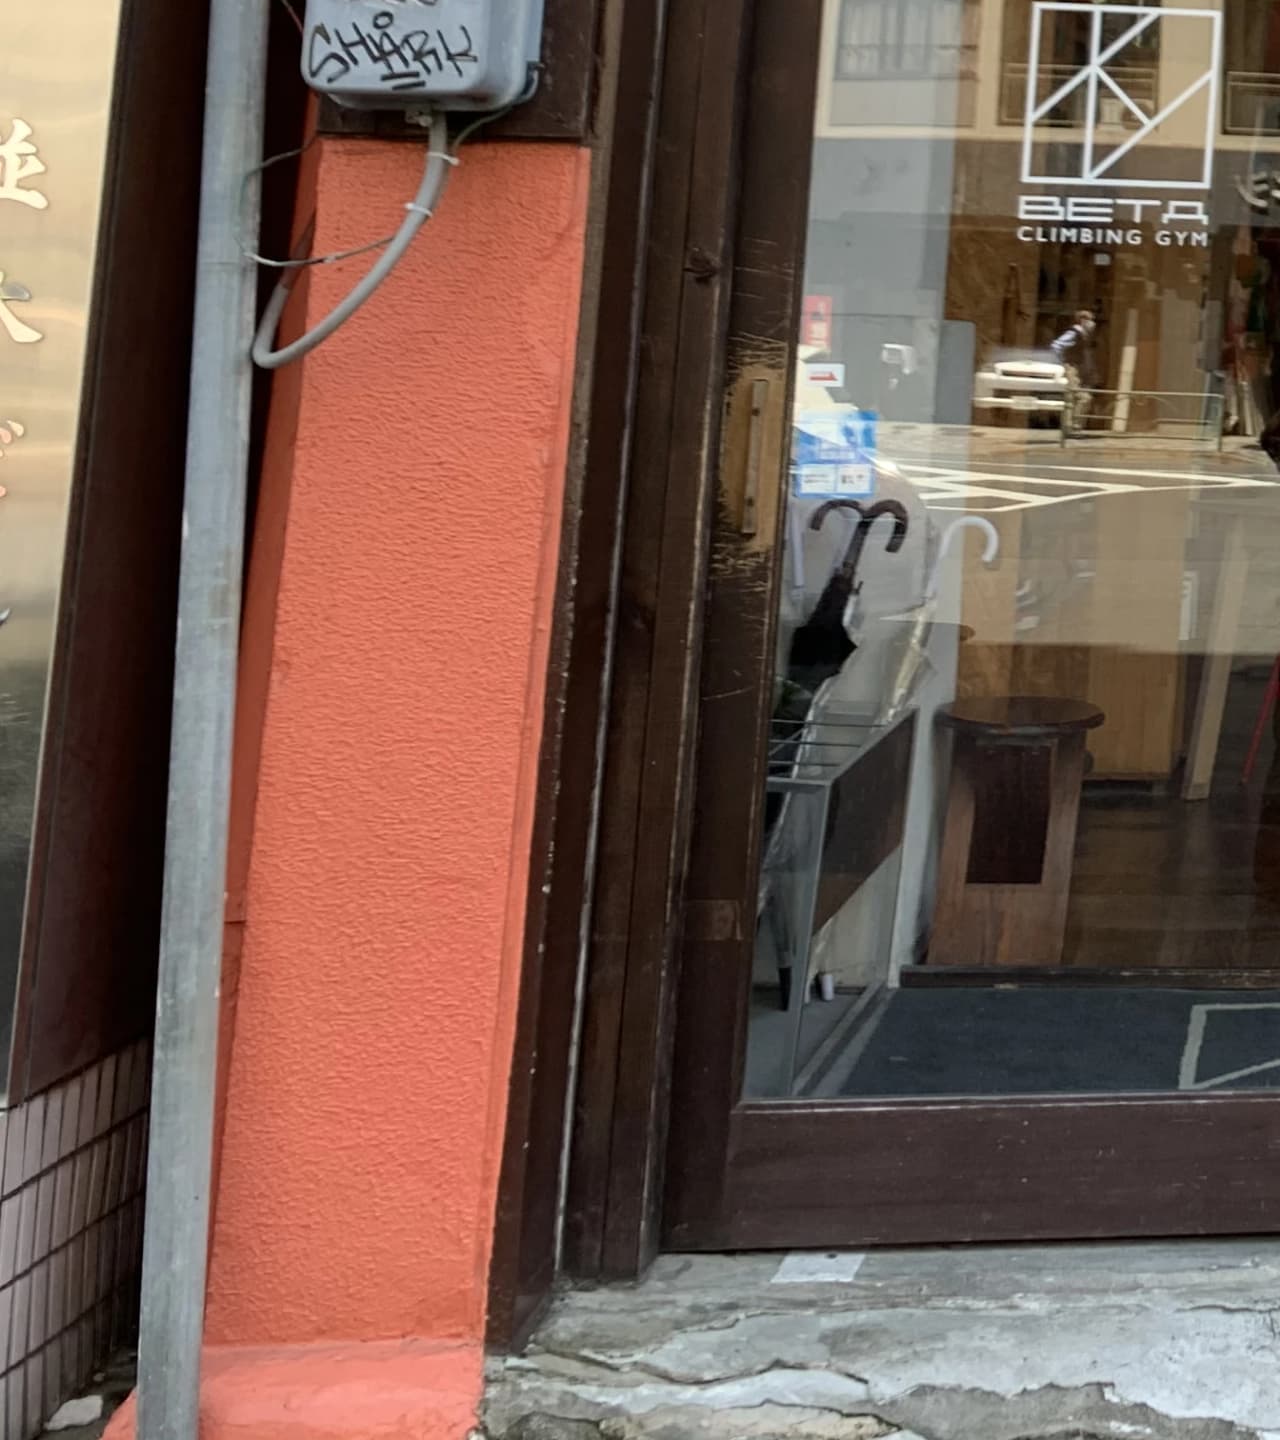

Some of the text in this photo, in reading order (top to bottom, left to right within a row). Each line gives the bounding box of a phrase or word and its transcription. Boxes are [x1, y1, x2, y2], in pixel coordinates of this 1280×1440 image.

[1018, 196, 1209, 224] BETA
[1017, 226, 1208, 247] CLIMBING GYM
